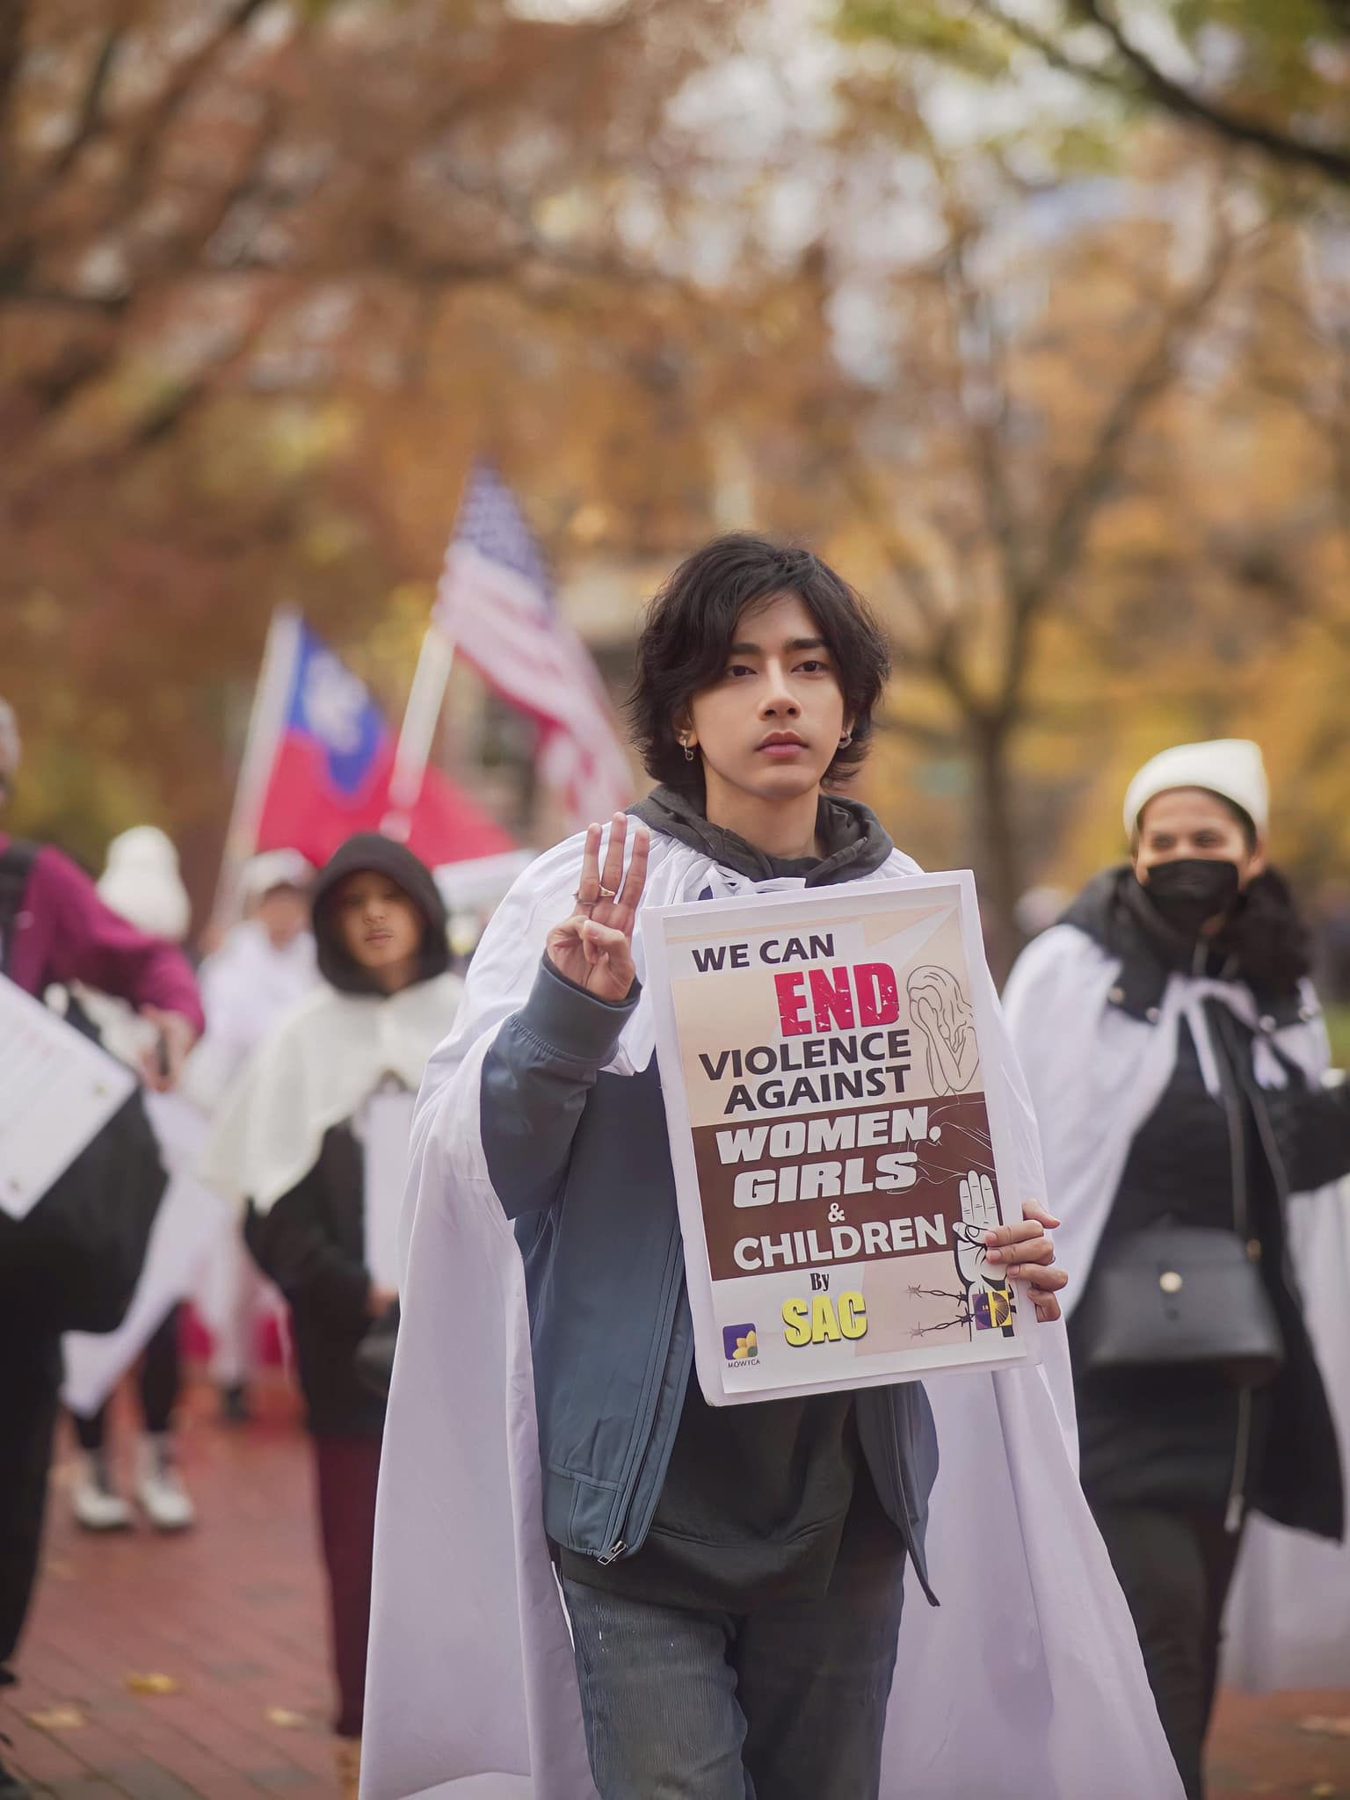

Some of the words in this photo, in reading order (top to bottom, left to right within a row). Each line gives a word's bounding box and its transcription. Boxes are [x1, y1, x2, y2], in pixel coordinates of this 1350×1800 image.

[692, 943, 750, 972] WE
[759, 933, 835, 964] CAN
[774, 962, 900, 1037] END
[698, 1029, 912, 1080] VIOLENCE
[723, 1064, 911, 1114] AGAINST
[715, 1106, 942, 1164] WOMEN,
[733, 1152, 917, 1208] GIRLS
[828, 1203, 845, 1223] &
[733, 1214, 947, 1270] CHILDREN
[810, 1273, 830, 1291] By
[782, 1292, 868, 1346] SAC
